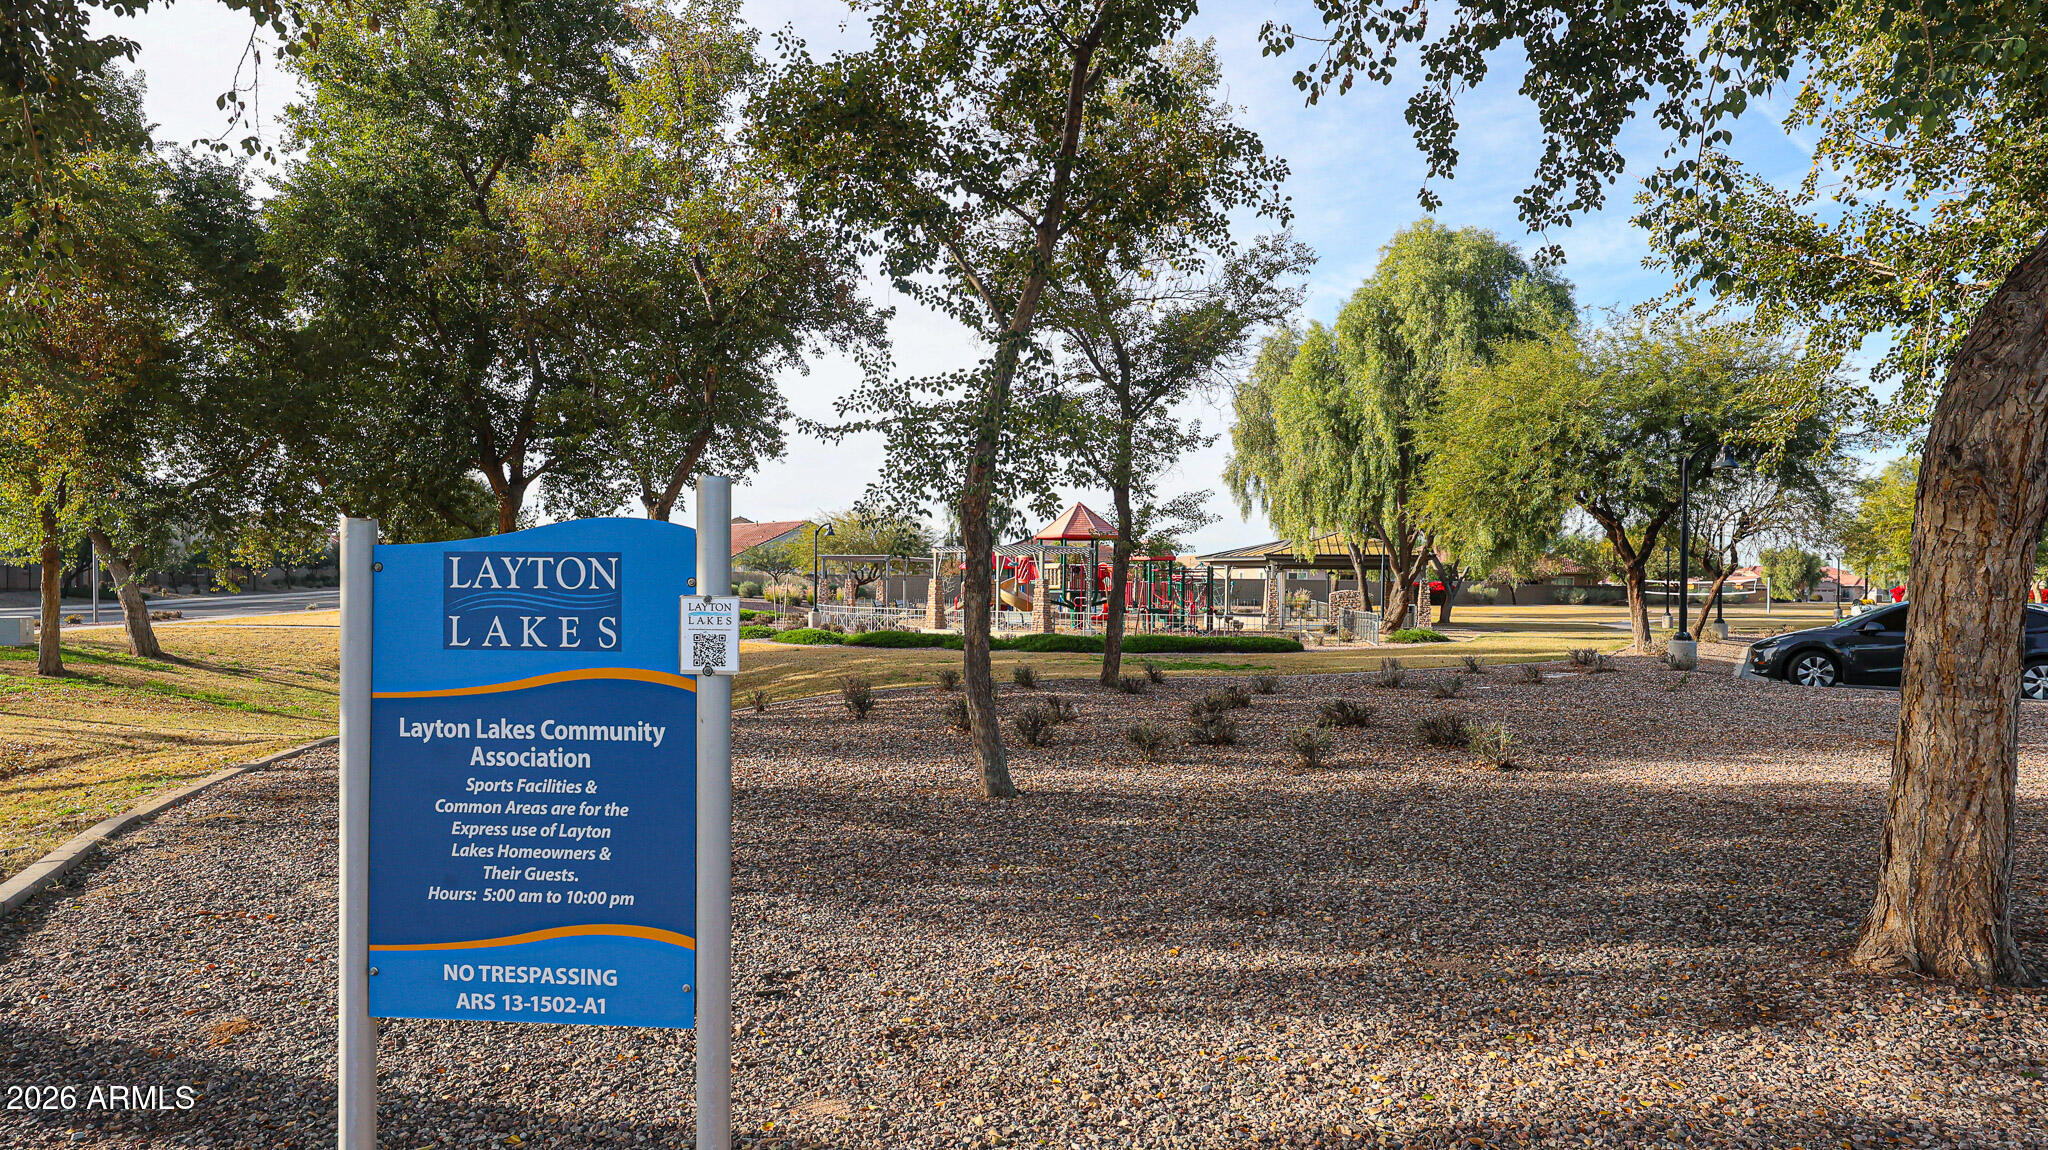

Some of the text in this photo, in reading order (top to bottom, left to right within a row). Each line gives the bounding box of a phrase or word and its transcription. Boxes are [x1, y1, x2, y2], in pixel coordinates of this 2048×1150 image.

[449, 557, 618, 589] LAYTON
[688, 603, 732, 611] LAYTON
[688, 616, 732, 625] LAKES
[449, 616, 616, 648] LAKES
[400, 718, 665, 747] Layton Lakes Community
[470, 746, 590, 768] Association
[466, 778, 597, 794] Sports Facilities &
[435, 799, 629, 816] Common Areas are for the
[452, 822, 610, 841] Express use of Layton
[452, 843, 611, 860] Lakes Homeowners &
[484, 866, 578, 881] Their Guests.
[428, 886, 634, 908] Hours: 5:00 am to 10:00 pm
[444, 964, 617, 986] NO TRESPASSING
[456, 993, 605, 1014] ARS 13-1502-A1
